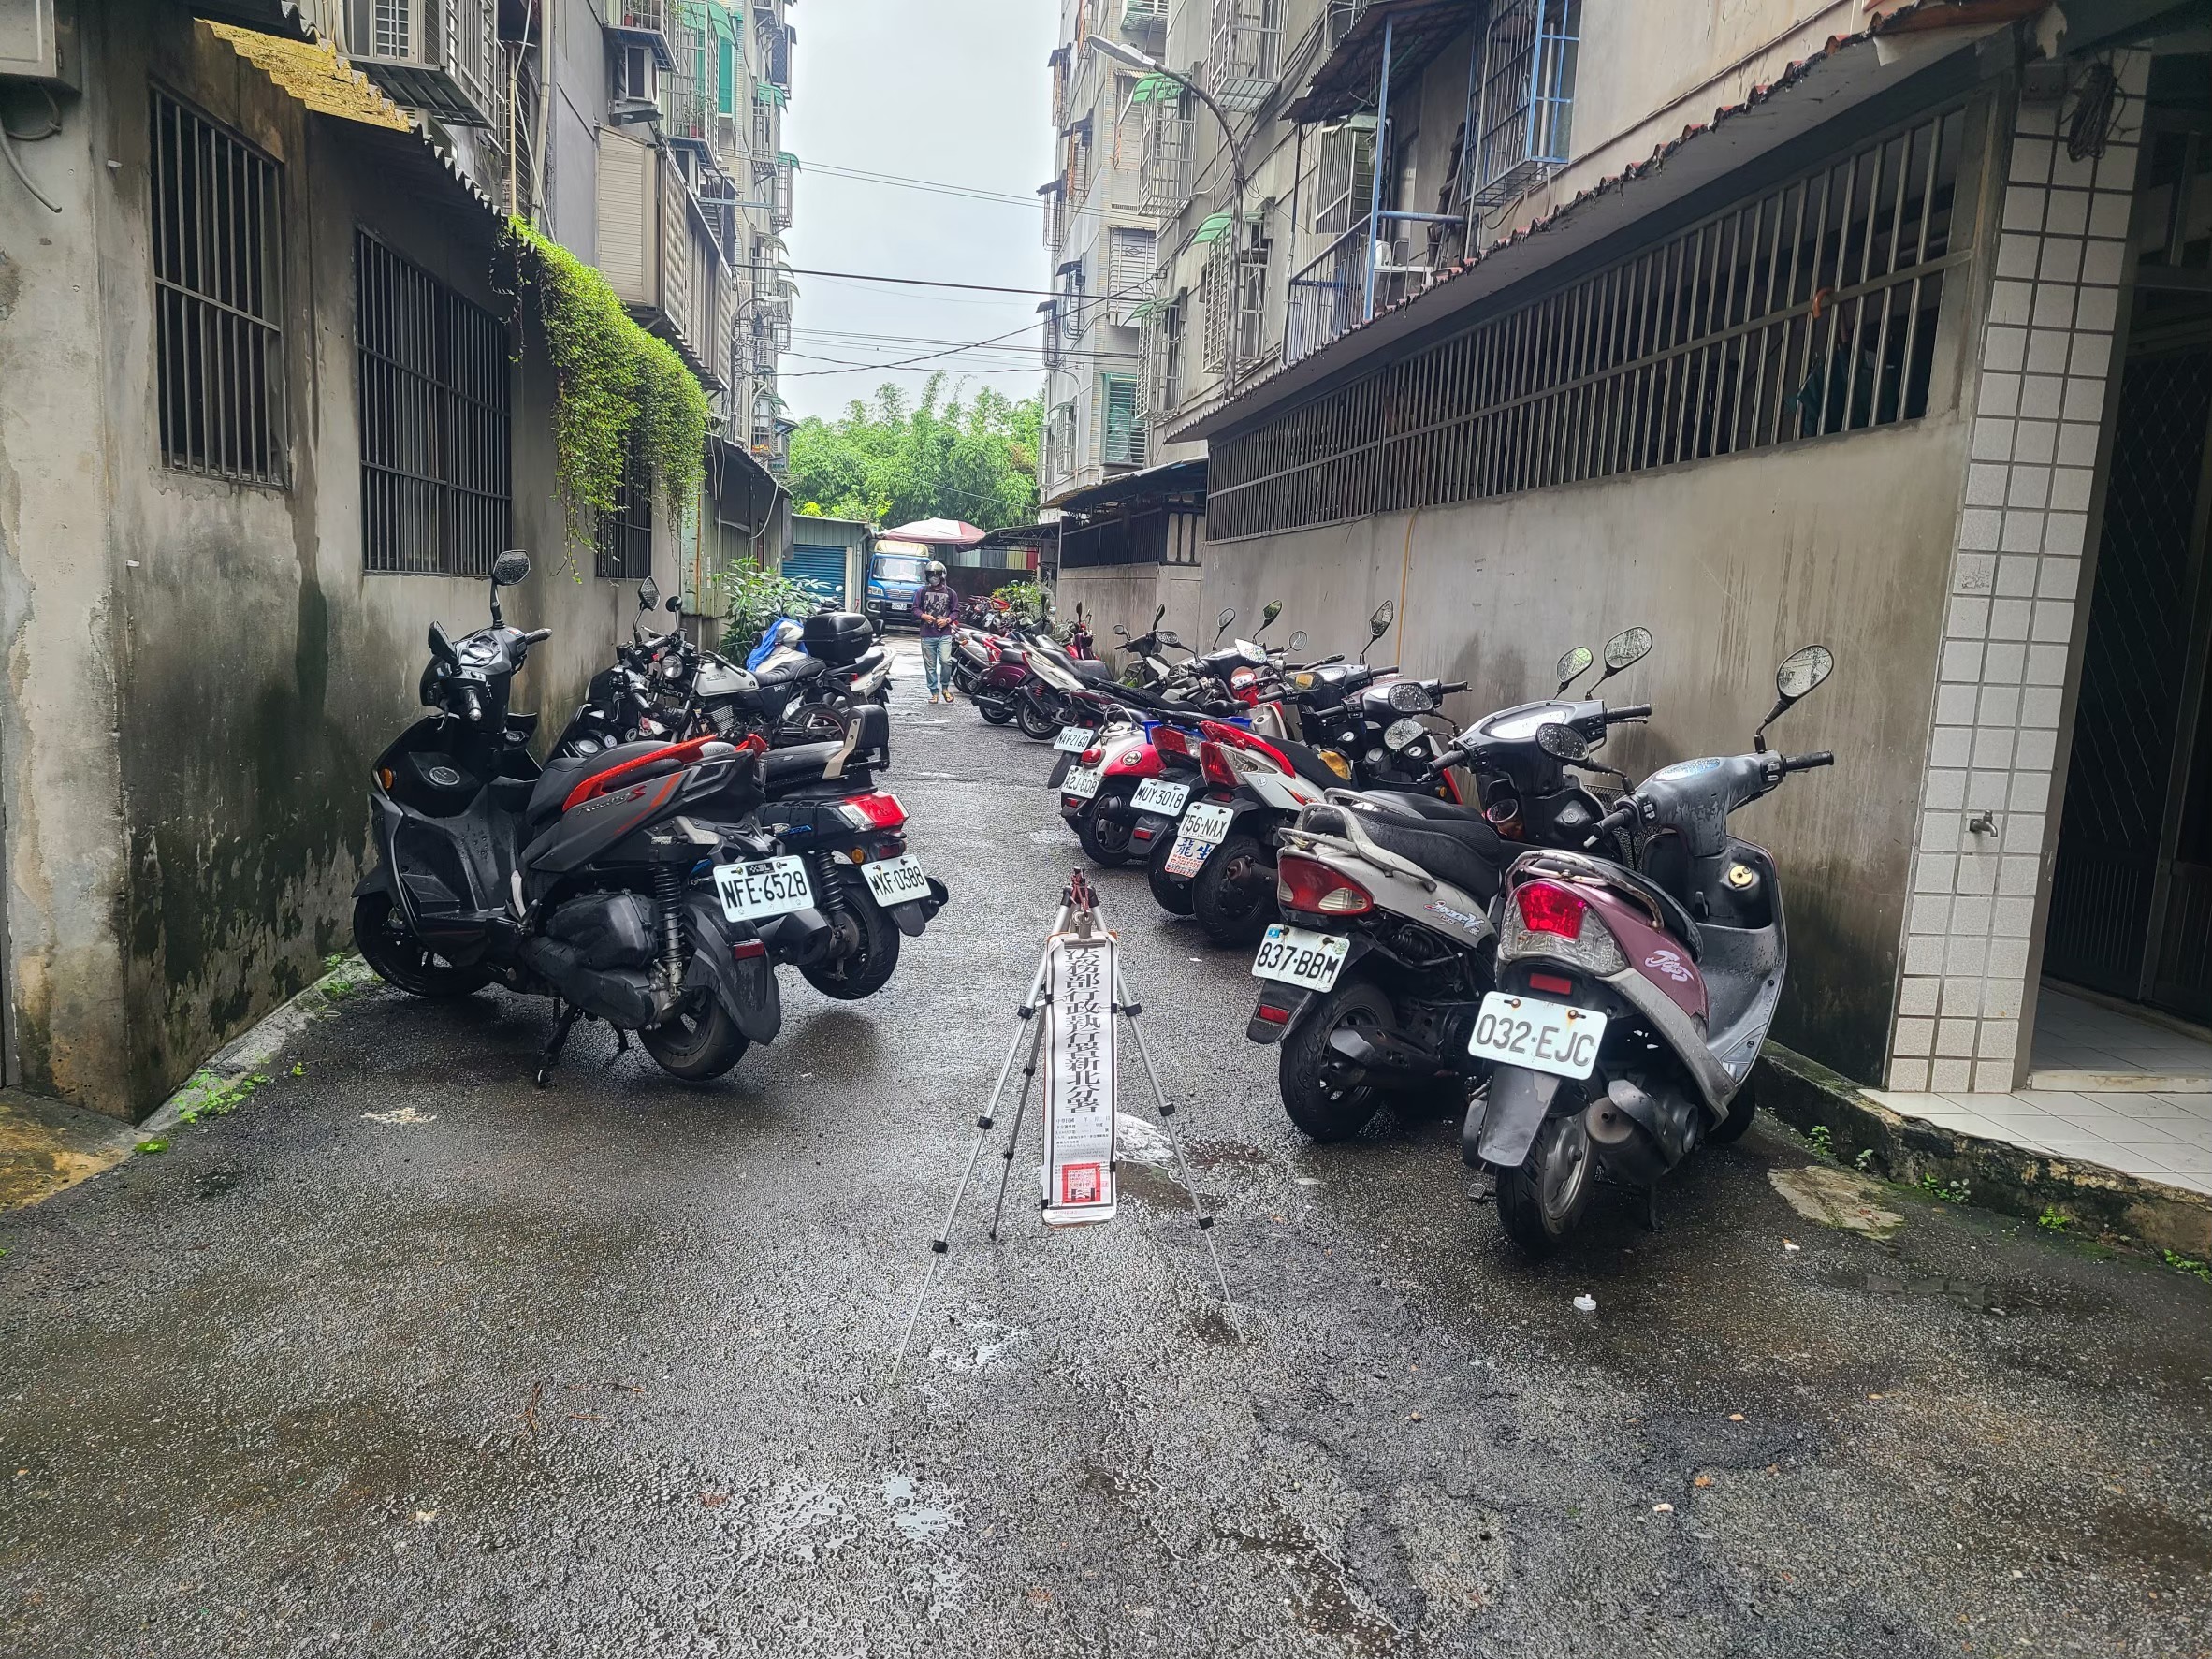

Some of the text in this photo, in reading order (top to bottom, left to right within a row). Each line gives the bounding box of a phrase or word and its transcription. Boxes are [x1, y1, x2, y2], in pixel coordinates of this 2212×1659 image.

[1064, 948, 1100, 1113] 法務部行政執行署新北分署
